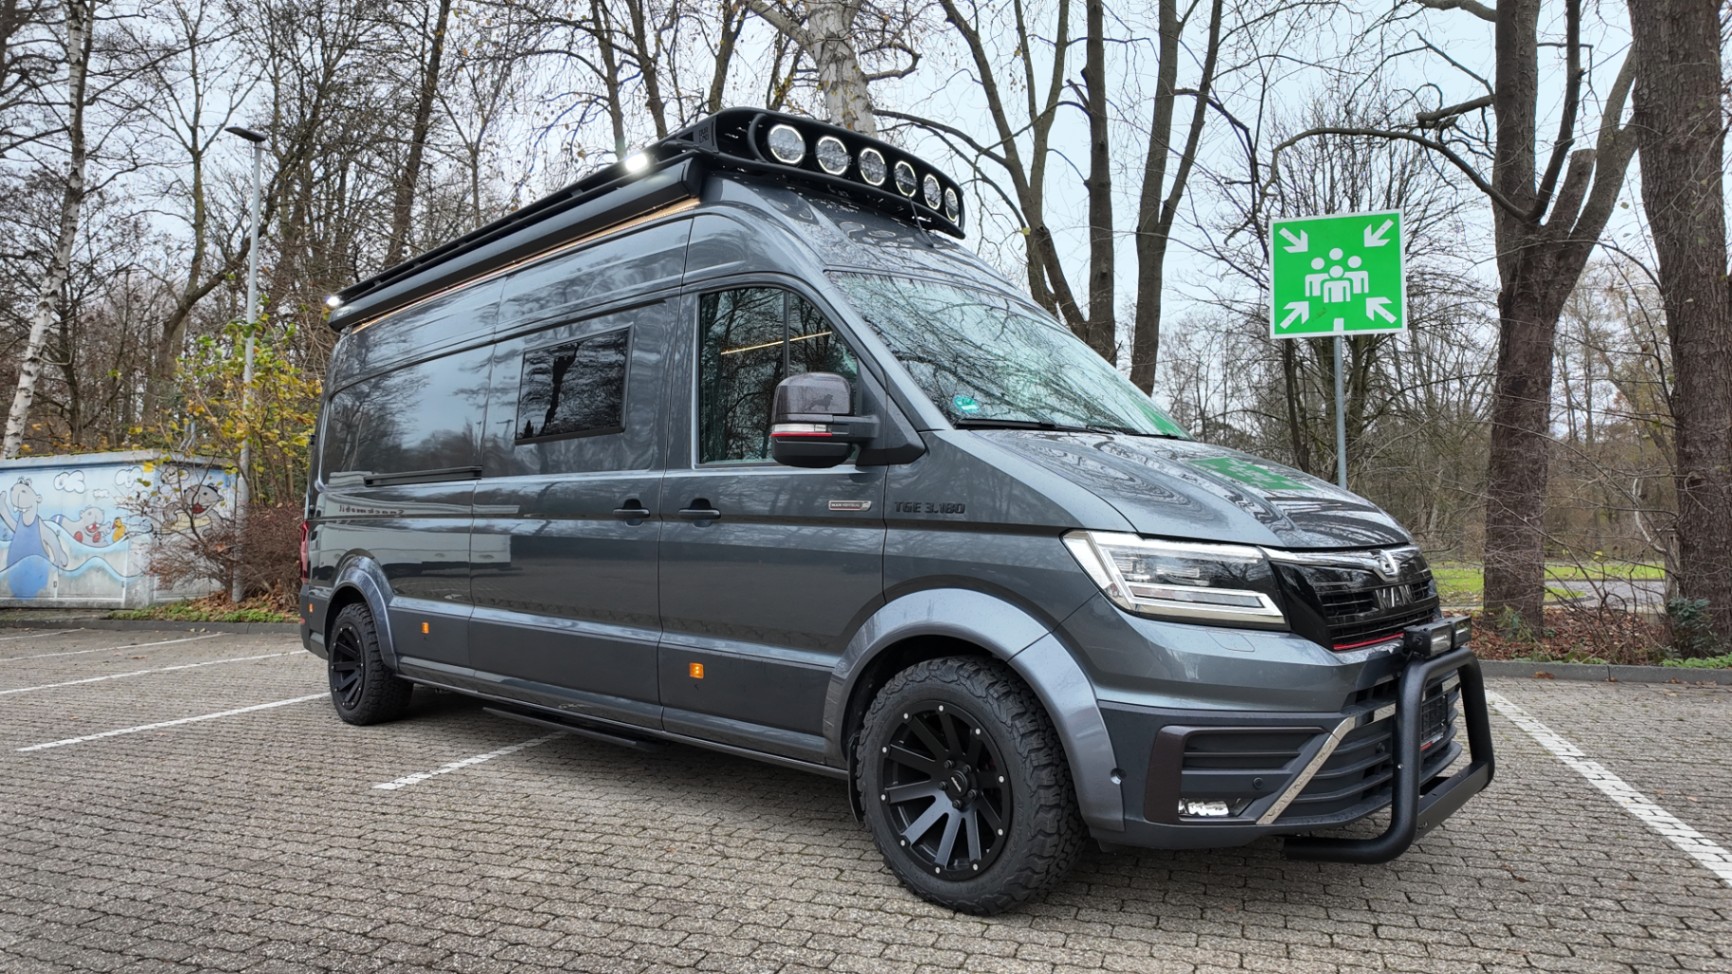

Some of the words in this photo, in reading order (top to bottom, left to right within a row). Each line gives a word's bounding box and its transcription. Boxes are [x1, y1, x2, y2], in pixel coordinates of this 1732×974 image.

[895, 501, 921, 513] TGE
[924, 502, 966, 514] 3.180
[1375, 584, 1414, 609] MAN
